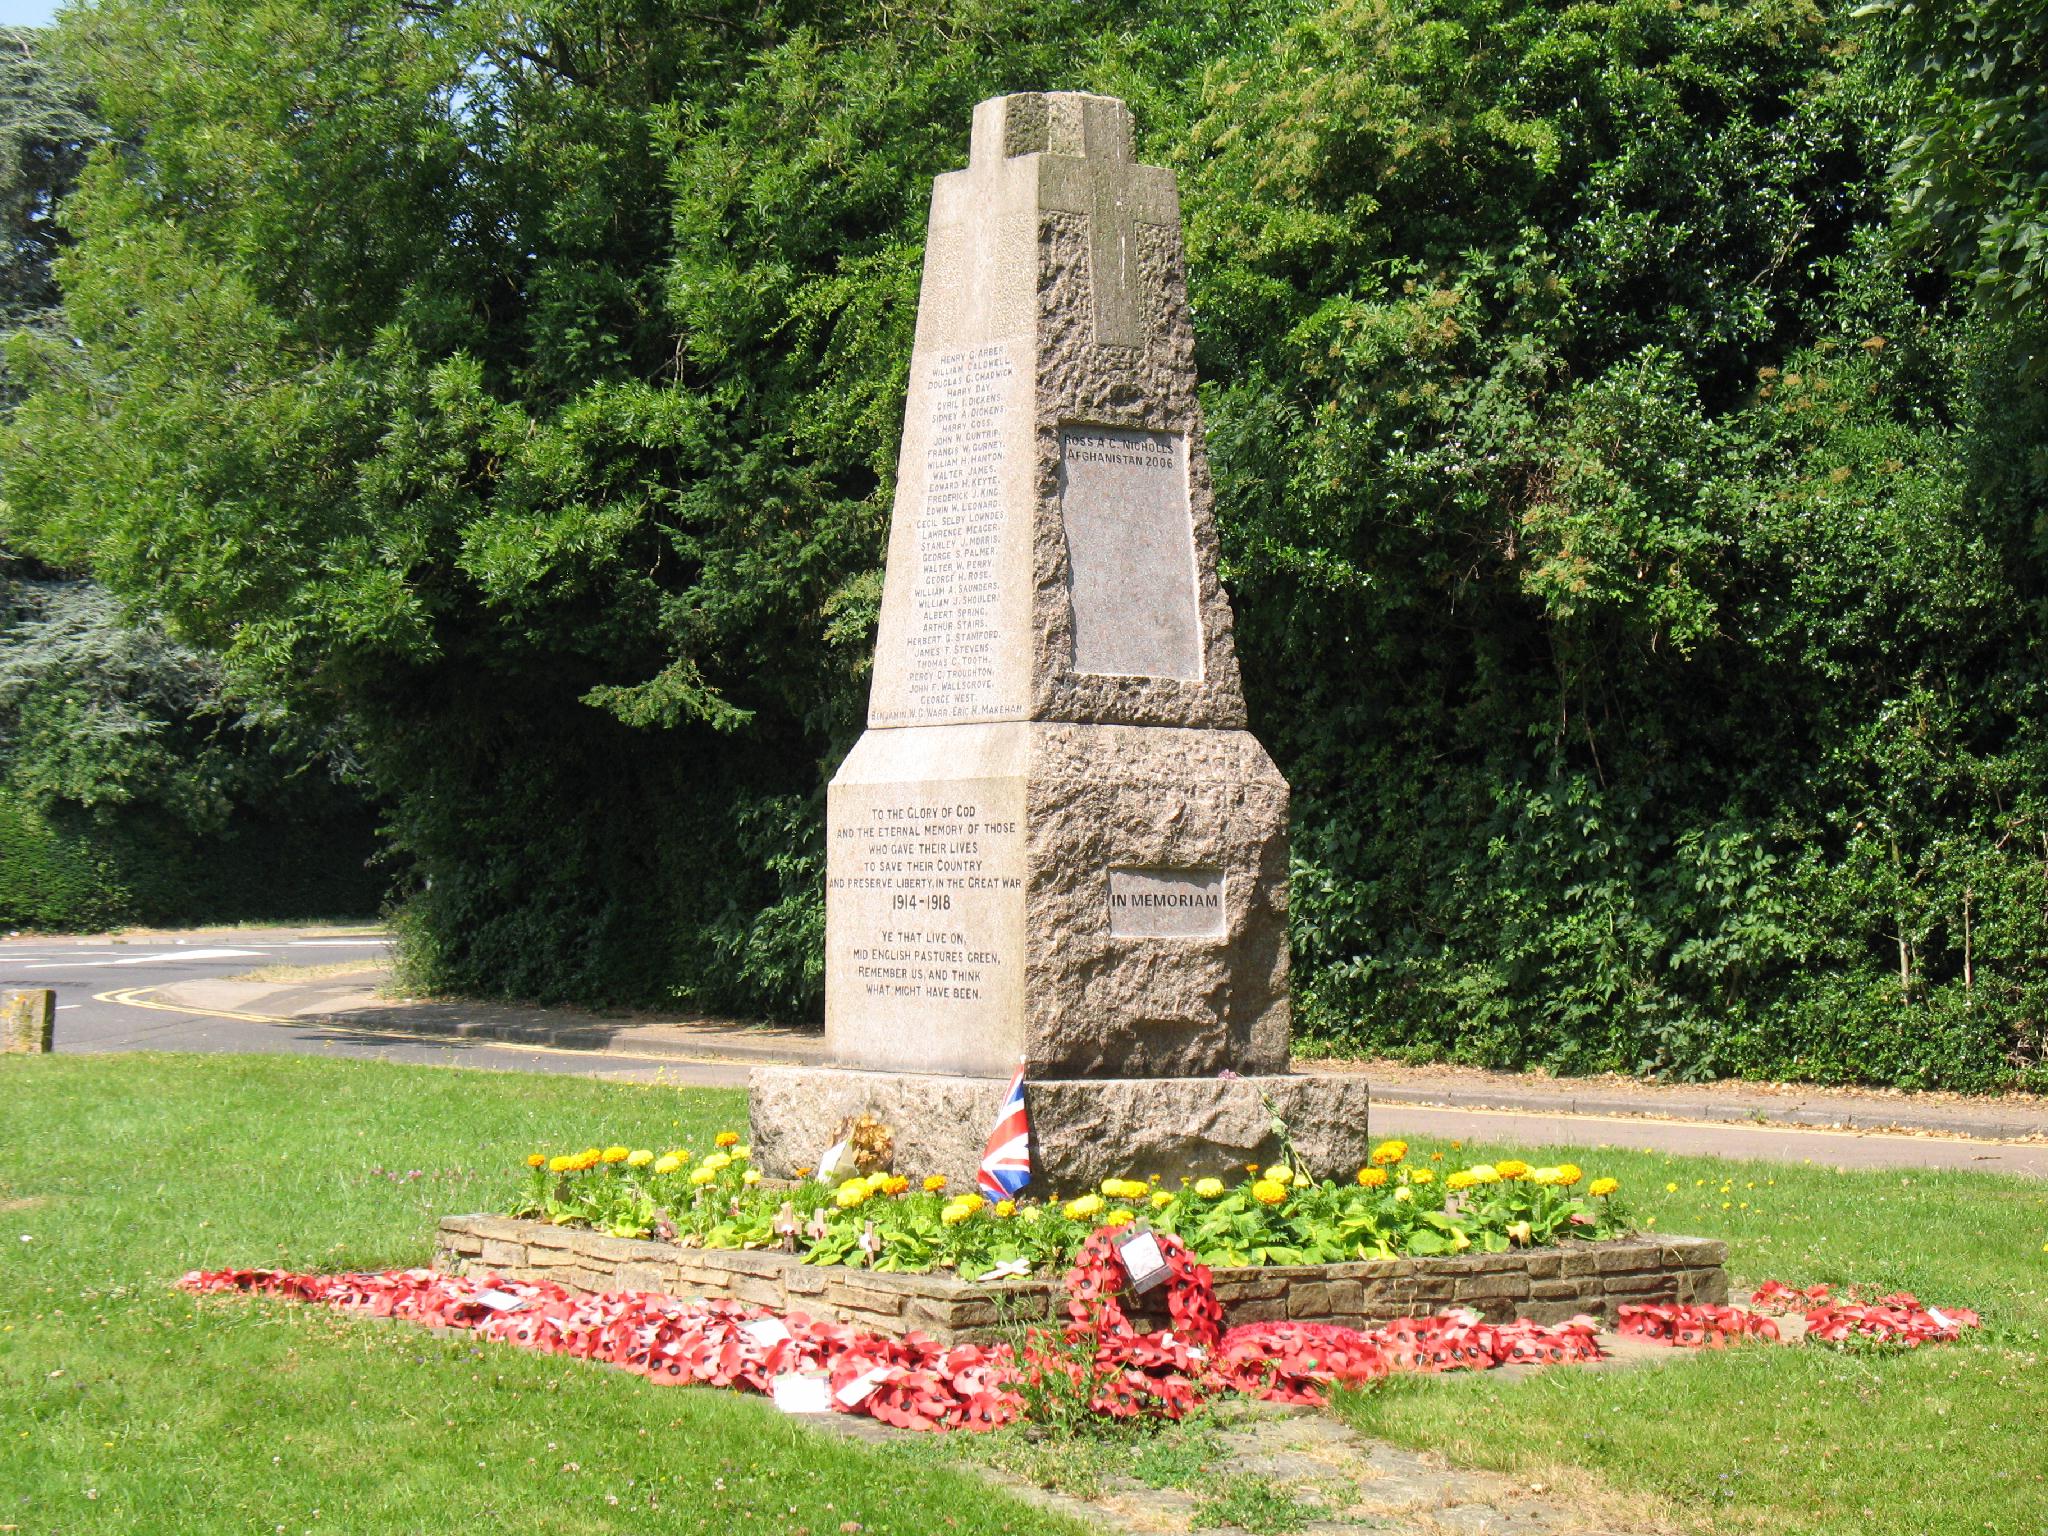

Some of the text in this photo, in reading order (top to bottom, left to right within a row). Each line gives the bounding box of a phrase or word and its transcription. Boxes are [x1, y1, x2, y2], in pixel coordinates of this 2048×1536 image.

[1064, 435, 1093, 446] ROSS
[1123, 440, 1174, 454] NICHOLLS
[1067, 449, 1172, 468] AFGHANISTAN 2006
[872, 805, 975, 819] TO THE GLORY OF GOD
[837, 823, 1016, 838] AND THE ETERNAL MEMORY OF THOSE
[869, 842, 978, 854] WHO GAVE THEIR LIVES
[864, 860, 982, 872] TO SAVE THEIR COUNTRY
[830, 878, 844, 888] AND
[848, 878, 892, 888] PRESERVE
[936, 878, 944, 888] IN
[947, 878, 964, 888] THE
[968, 877, 998, 888] GREAT
[1002, 878, 1021, 888] WAR
[1112, 894, 1217, 907] IN MEMORIAM
[882, 931, 893, 942] YE
[898, 932, 921, 943] THAT
[927, 932, 946, 943] LIVE
[872, 949, 911, 960] ENGLISH
[914, 951, 963, 962] PASTURES
[968, 953, 1001, 965] GREEN,
[858, 967, 907, 979] REMEMBER
[929, 970, 948, 980] AND
[952, 970, 980, 981] THINK
[866, 985, 982, 1000] WHAT MIGHT HAVE BEEN.
